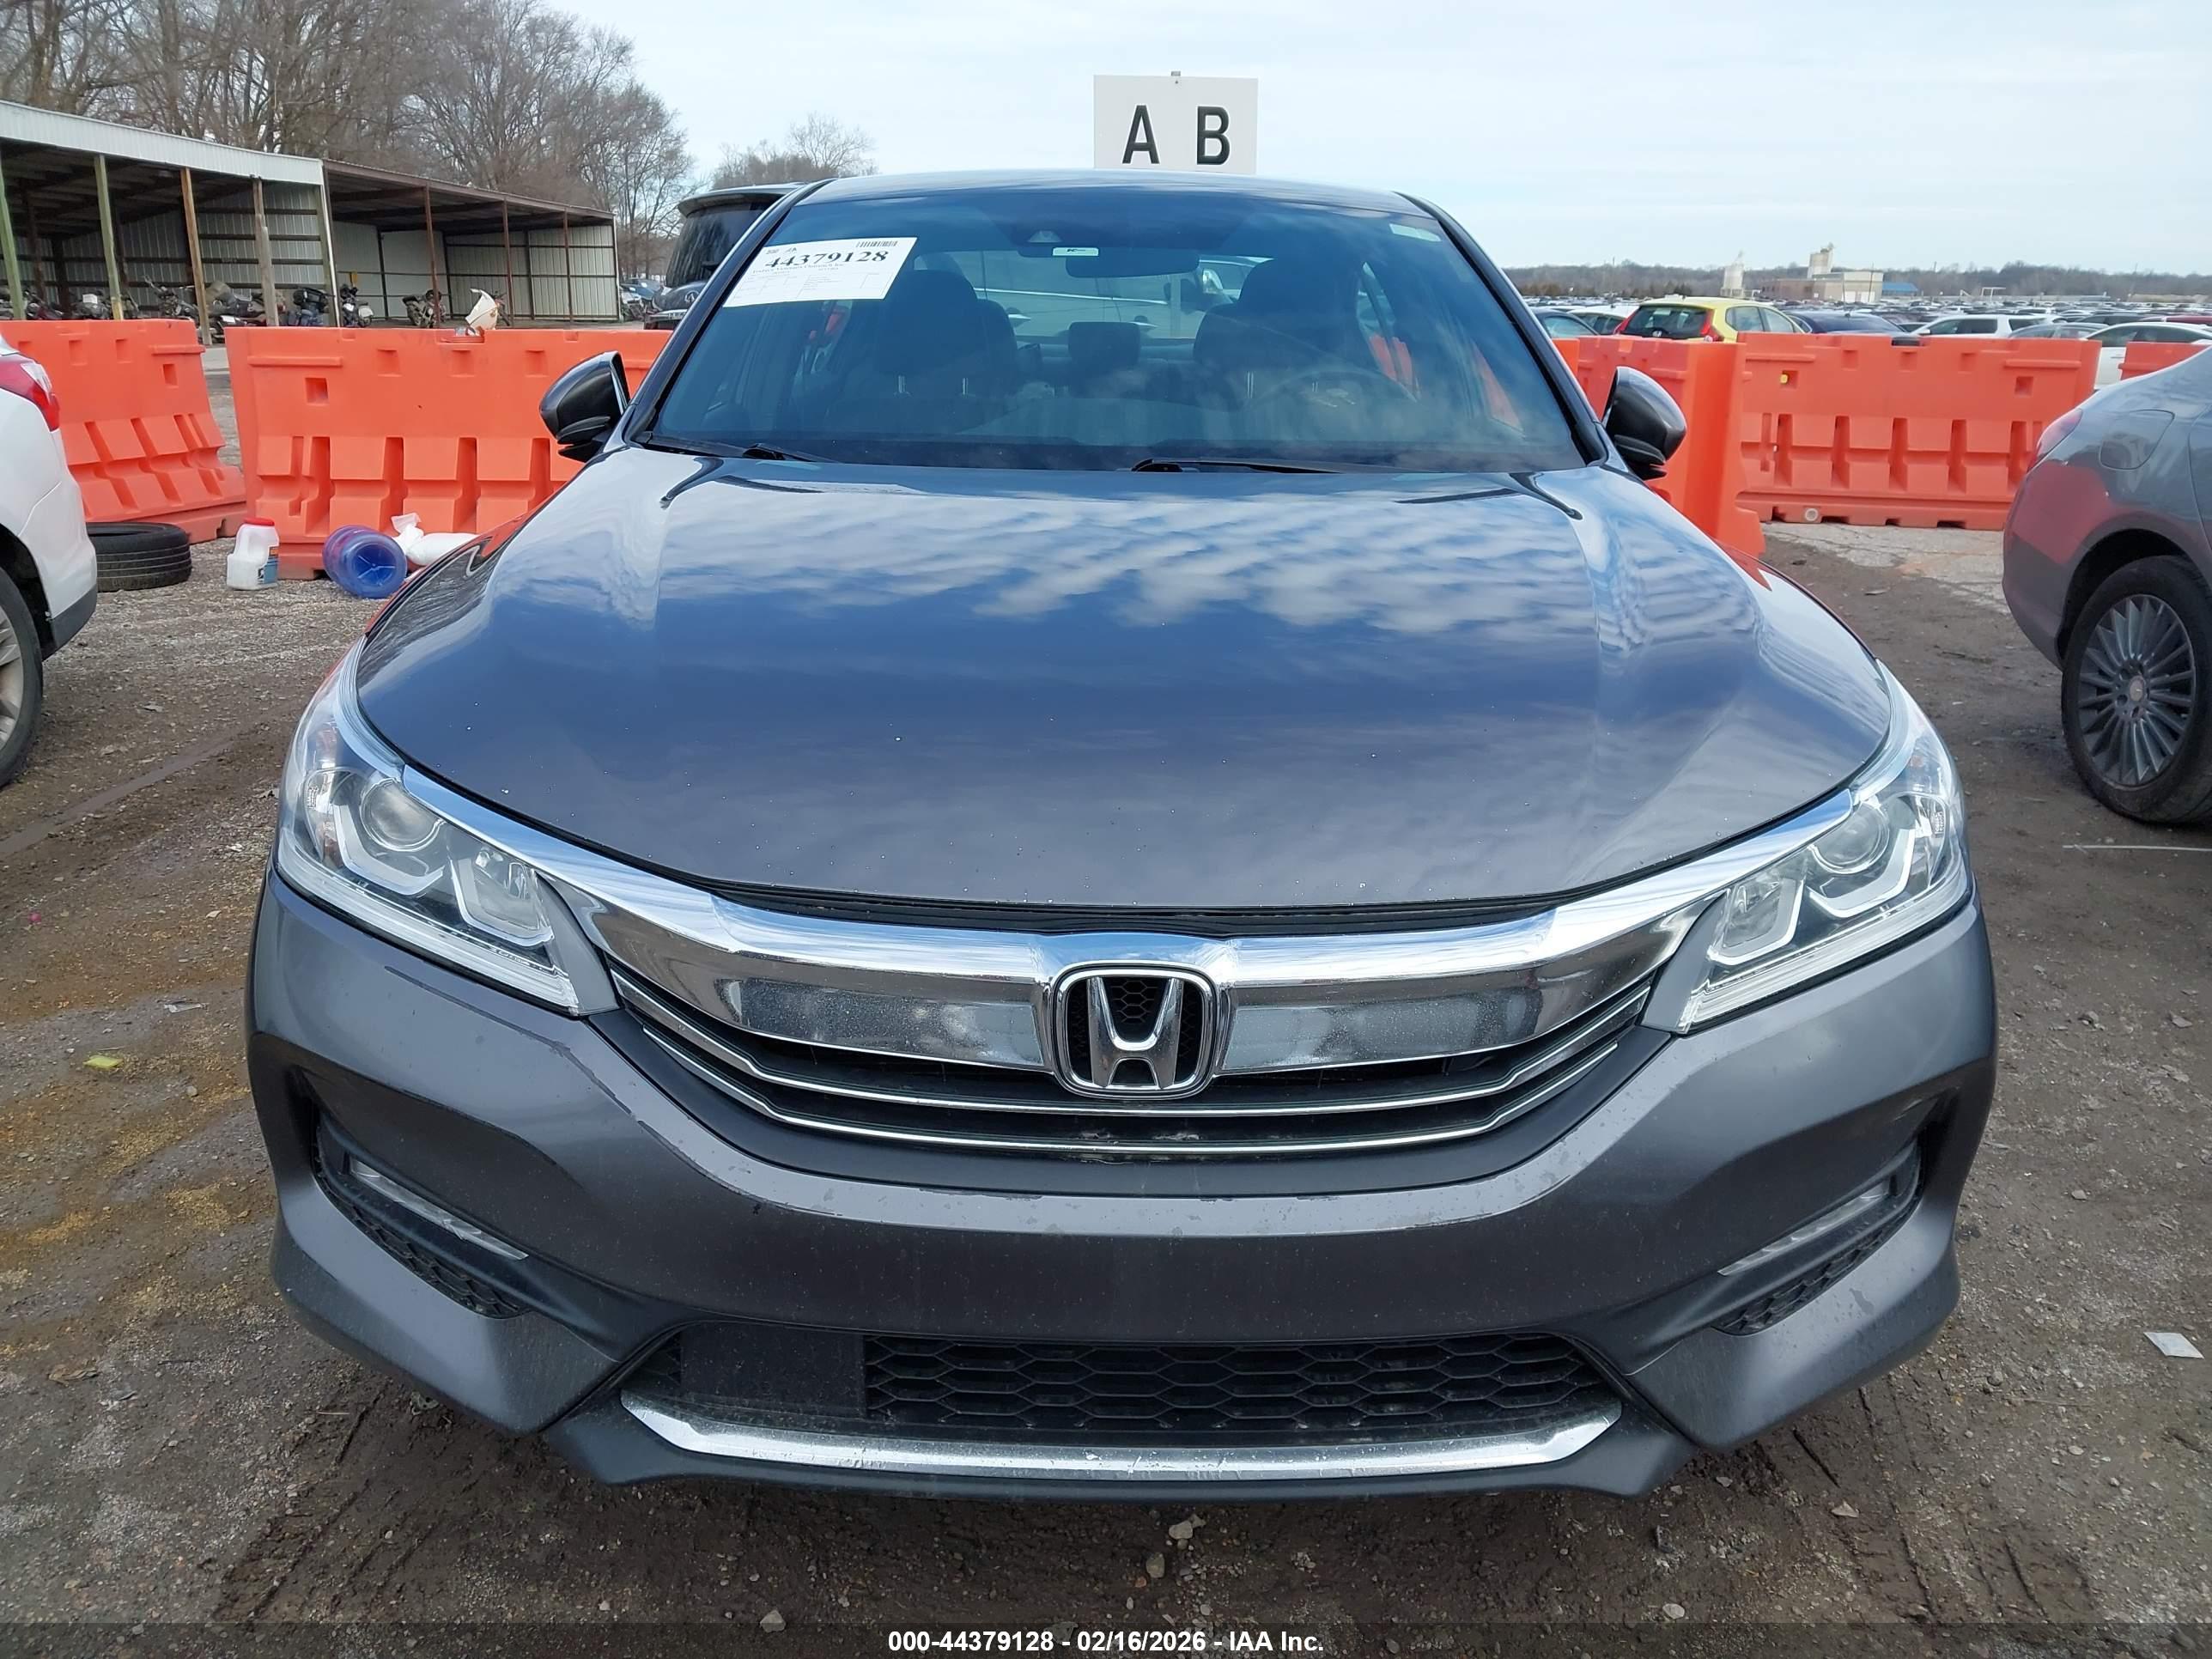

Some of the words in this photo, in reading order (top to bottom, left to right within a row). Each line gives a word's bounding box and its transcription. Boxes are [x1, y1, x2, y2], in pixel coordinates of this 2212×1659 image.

[1122, 106, 1159, 164] A
[1197, 106, 1230, 165] B
[765, 251, 888, 268] 44379128
